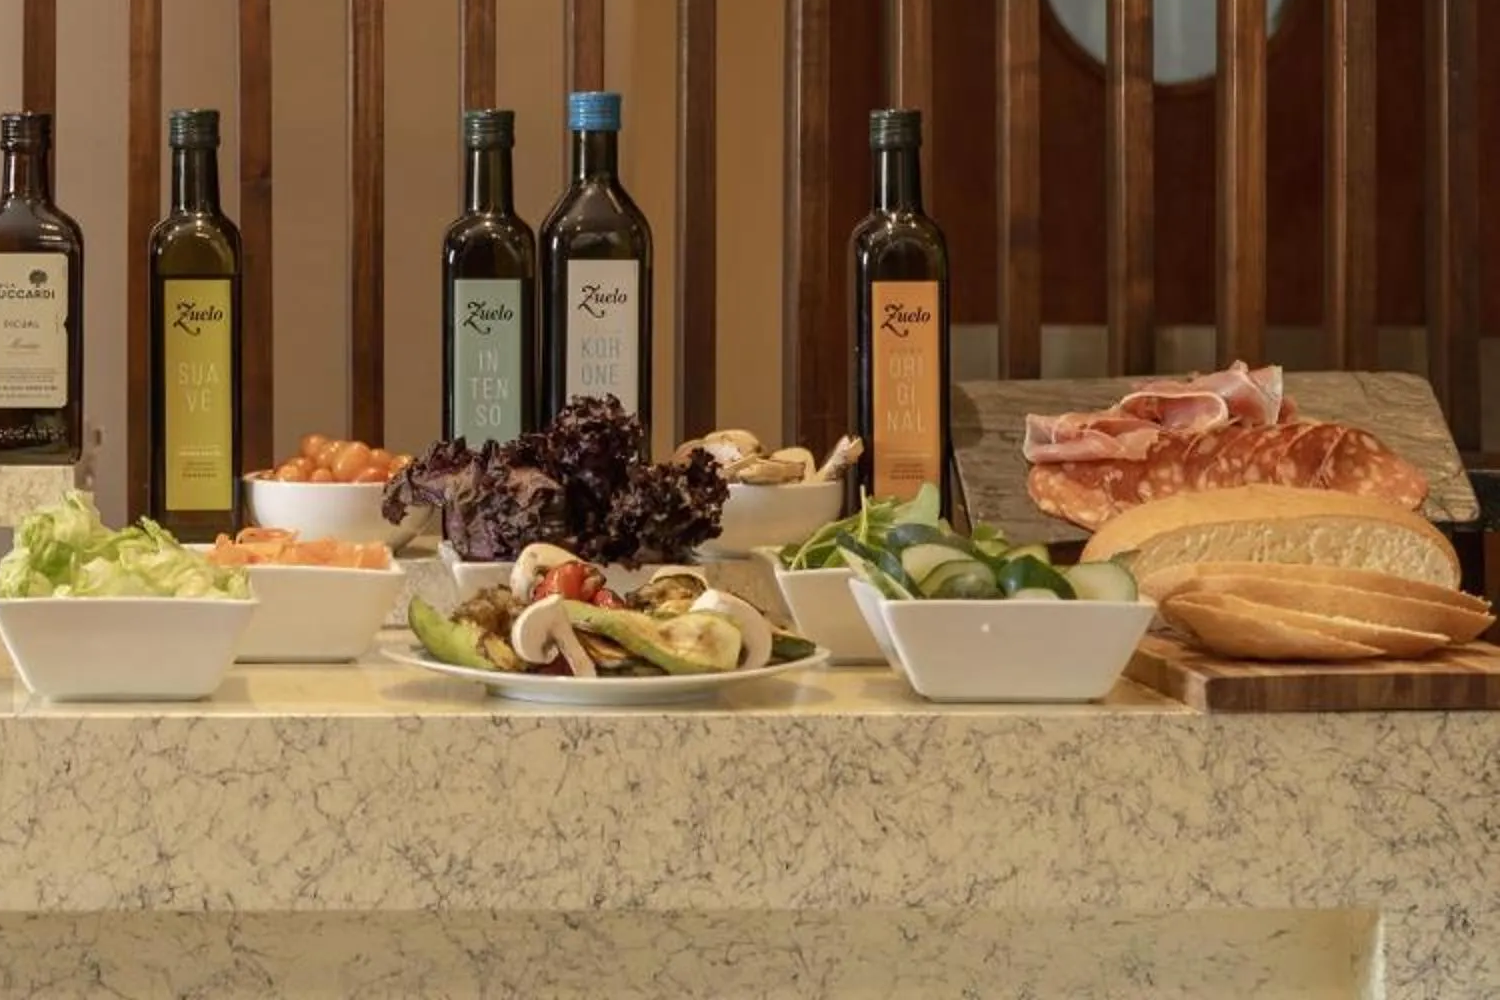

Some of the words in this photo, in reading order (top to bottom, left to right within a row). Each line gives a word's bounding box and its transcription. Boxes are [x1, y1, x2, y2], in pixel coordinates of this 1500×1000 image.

[577, 283, 628, 319] Zuelo
[172, 300, 224, 337] Zuelo
[463, 300, 514, 335] Zuelo
[880, 303, 931, 338] Zuelo
[178, 362, 220, 385] SUA
[478, 351, 499, 373] IN
[468, 377, 509, 399] TEN
[186, 389, 213, 413] VE
[475, 405, 502, 427] SO
